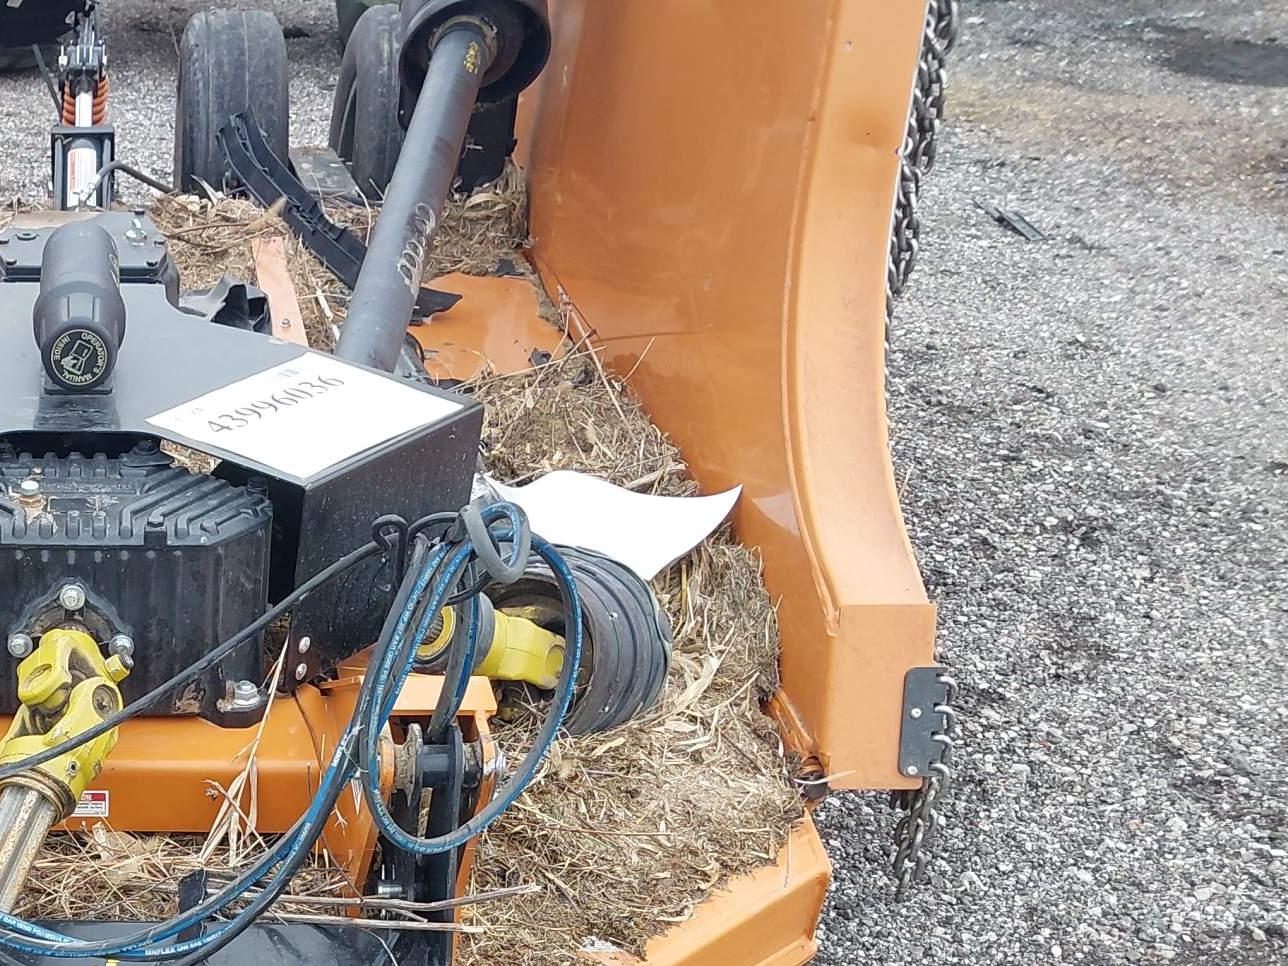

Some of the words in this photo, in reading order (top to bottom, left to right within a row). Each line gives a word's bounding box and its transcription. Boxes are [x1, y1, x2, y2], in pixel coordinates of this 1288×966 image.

[53, 335, 71, 360] INSIDE
[81, 332, 105, 374] OPERATOR'S
[62, 369, 92, 383] MANUAL
[207, 375, 345, 433] 43996036
